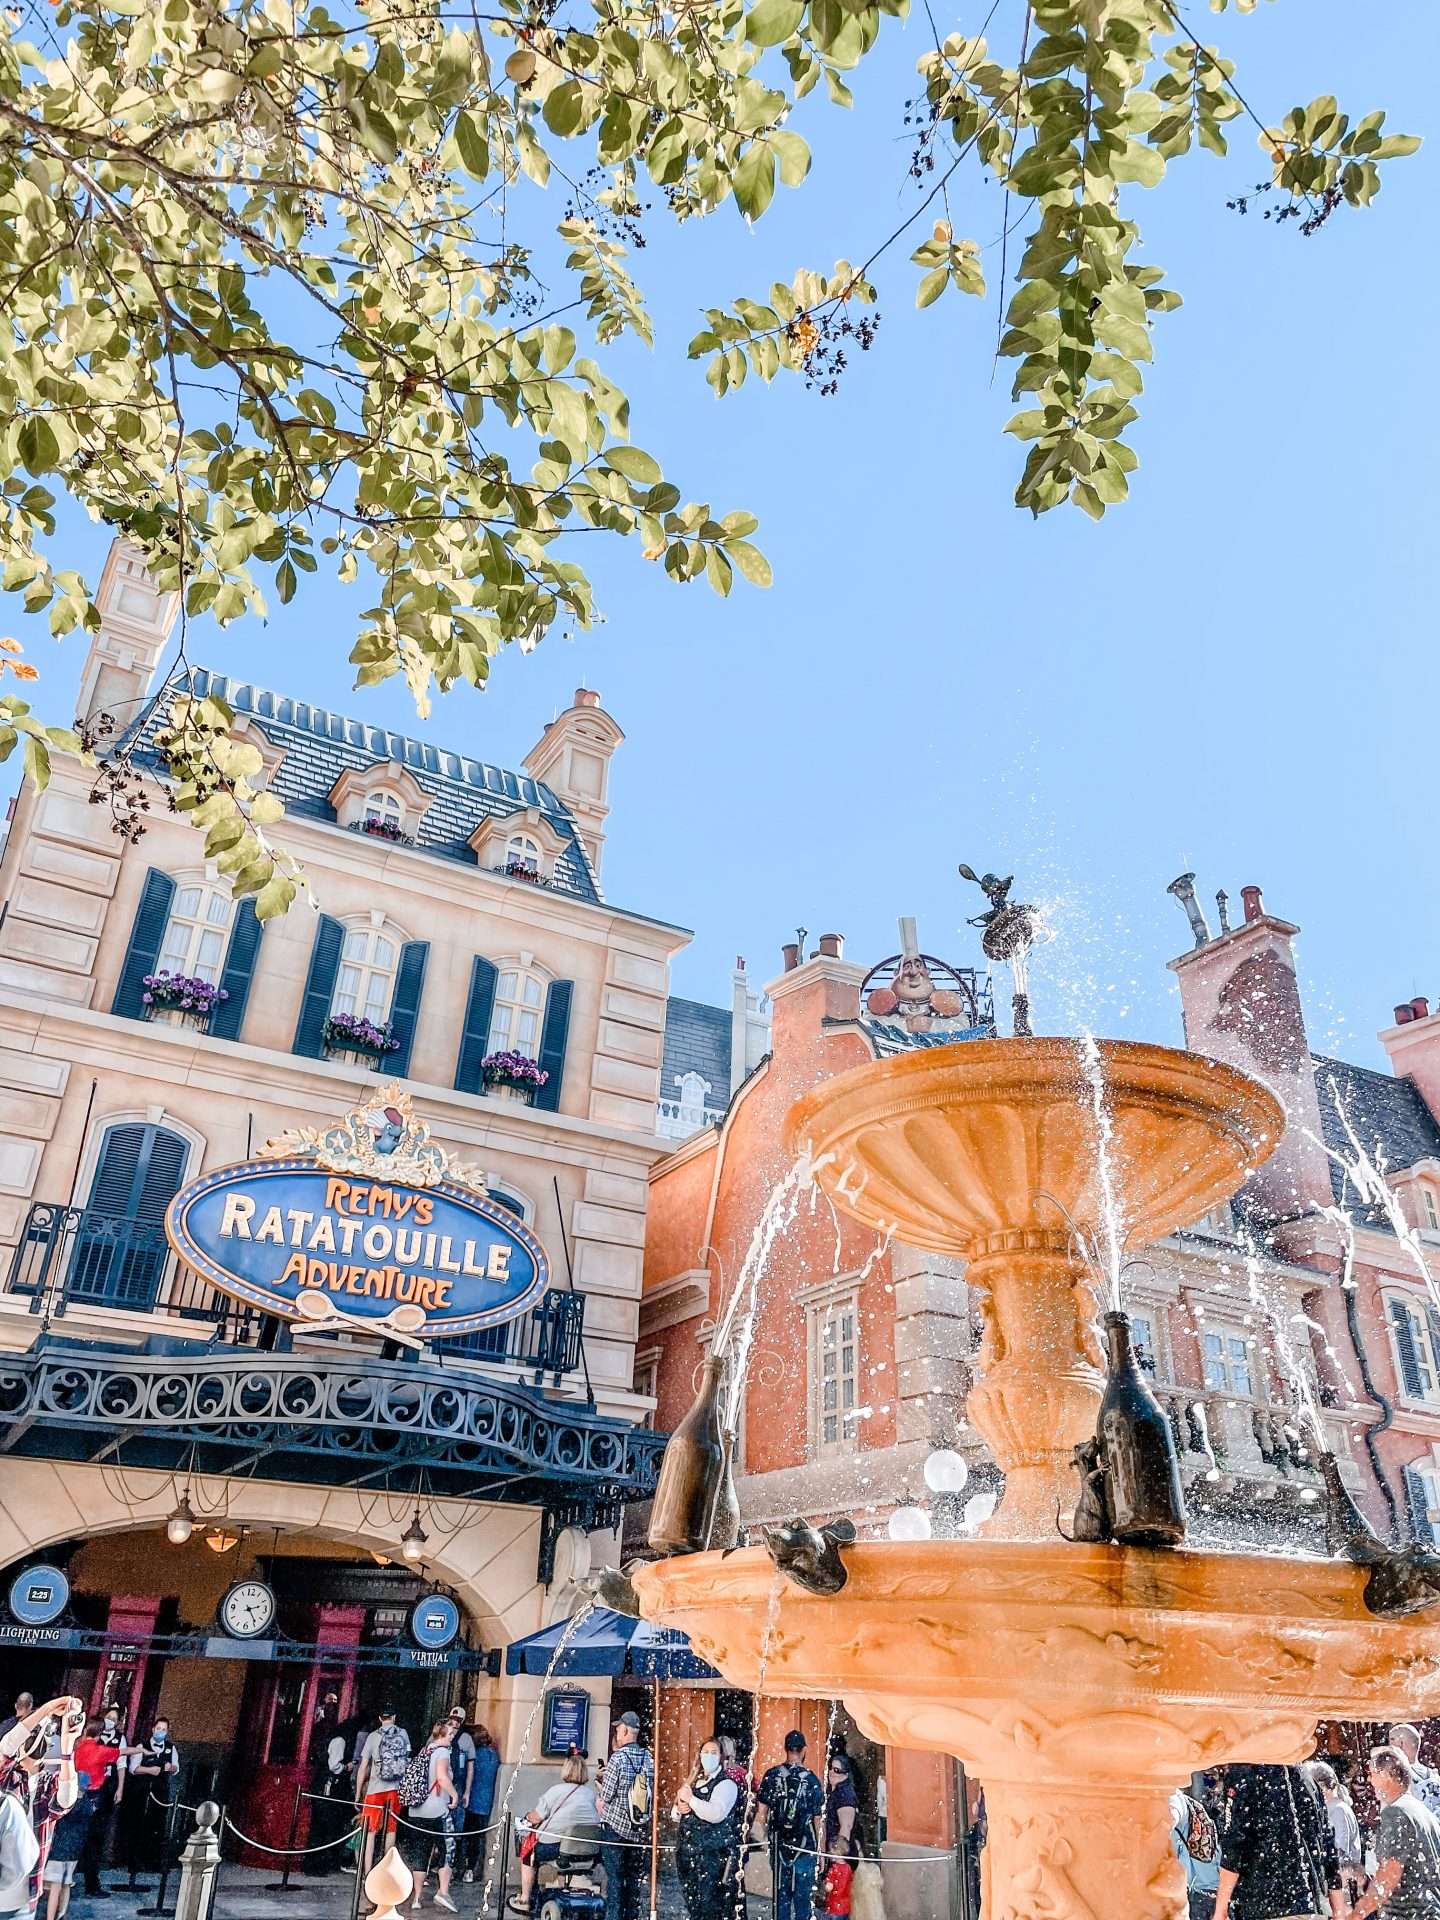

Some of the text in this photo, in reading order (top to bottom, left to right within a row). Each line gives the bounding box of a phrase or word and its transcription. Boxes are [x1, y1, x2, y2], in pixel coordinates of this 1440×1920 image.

[218, 1192, 513, 1284] RATATOUILLE
[271, 1252, 454, 1311] ADVENTURE
[31, 1590, 48, 1600] 2:25
[0, 1627, 60, 1640] LIGHTNING
[20, 1637, 37, 1645] LANE
[411, 1651, 449, 1663] VIRTUAL
